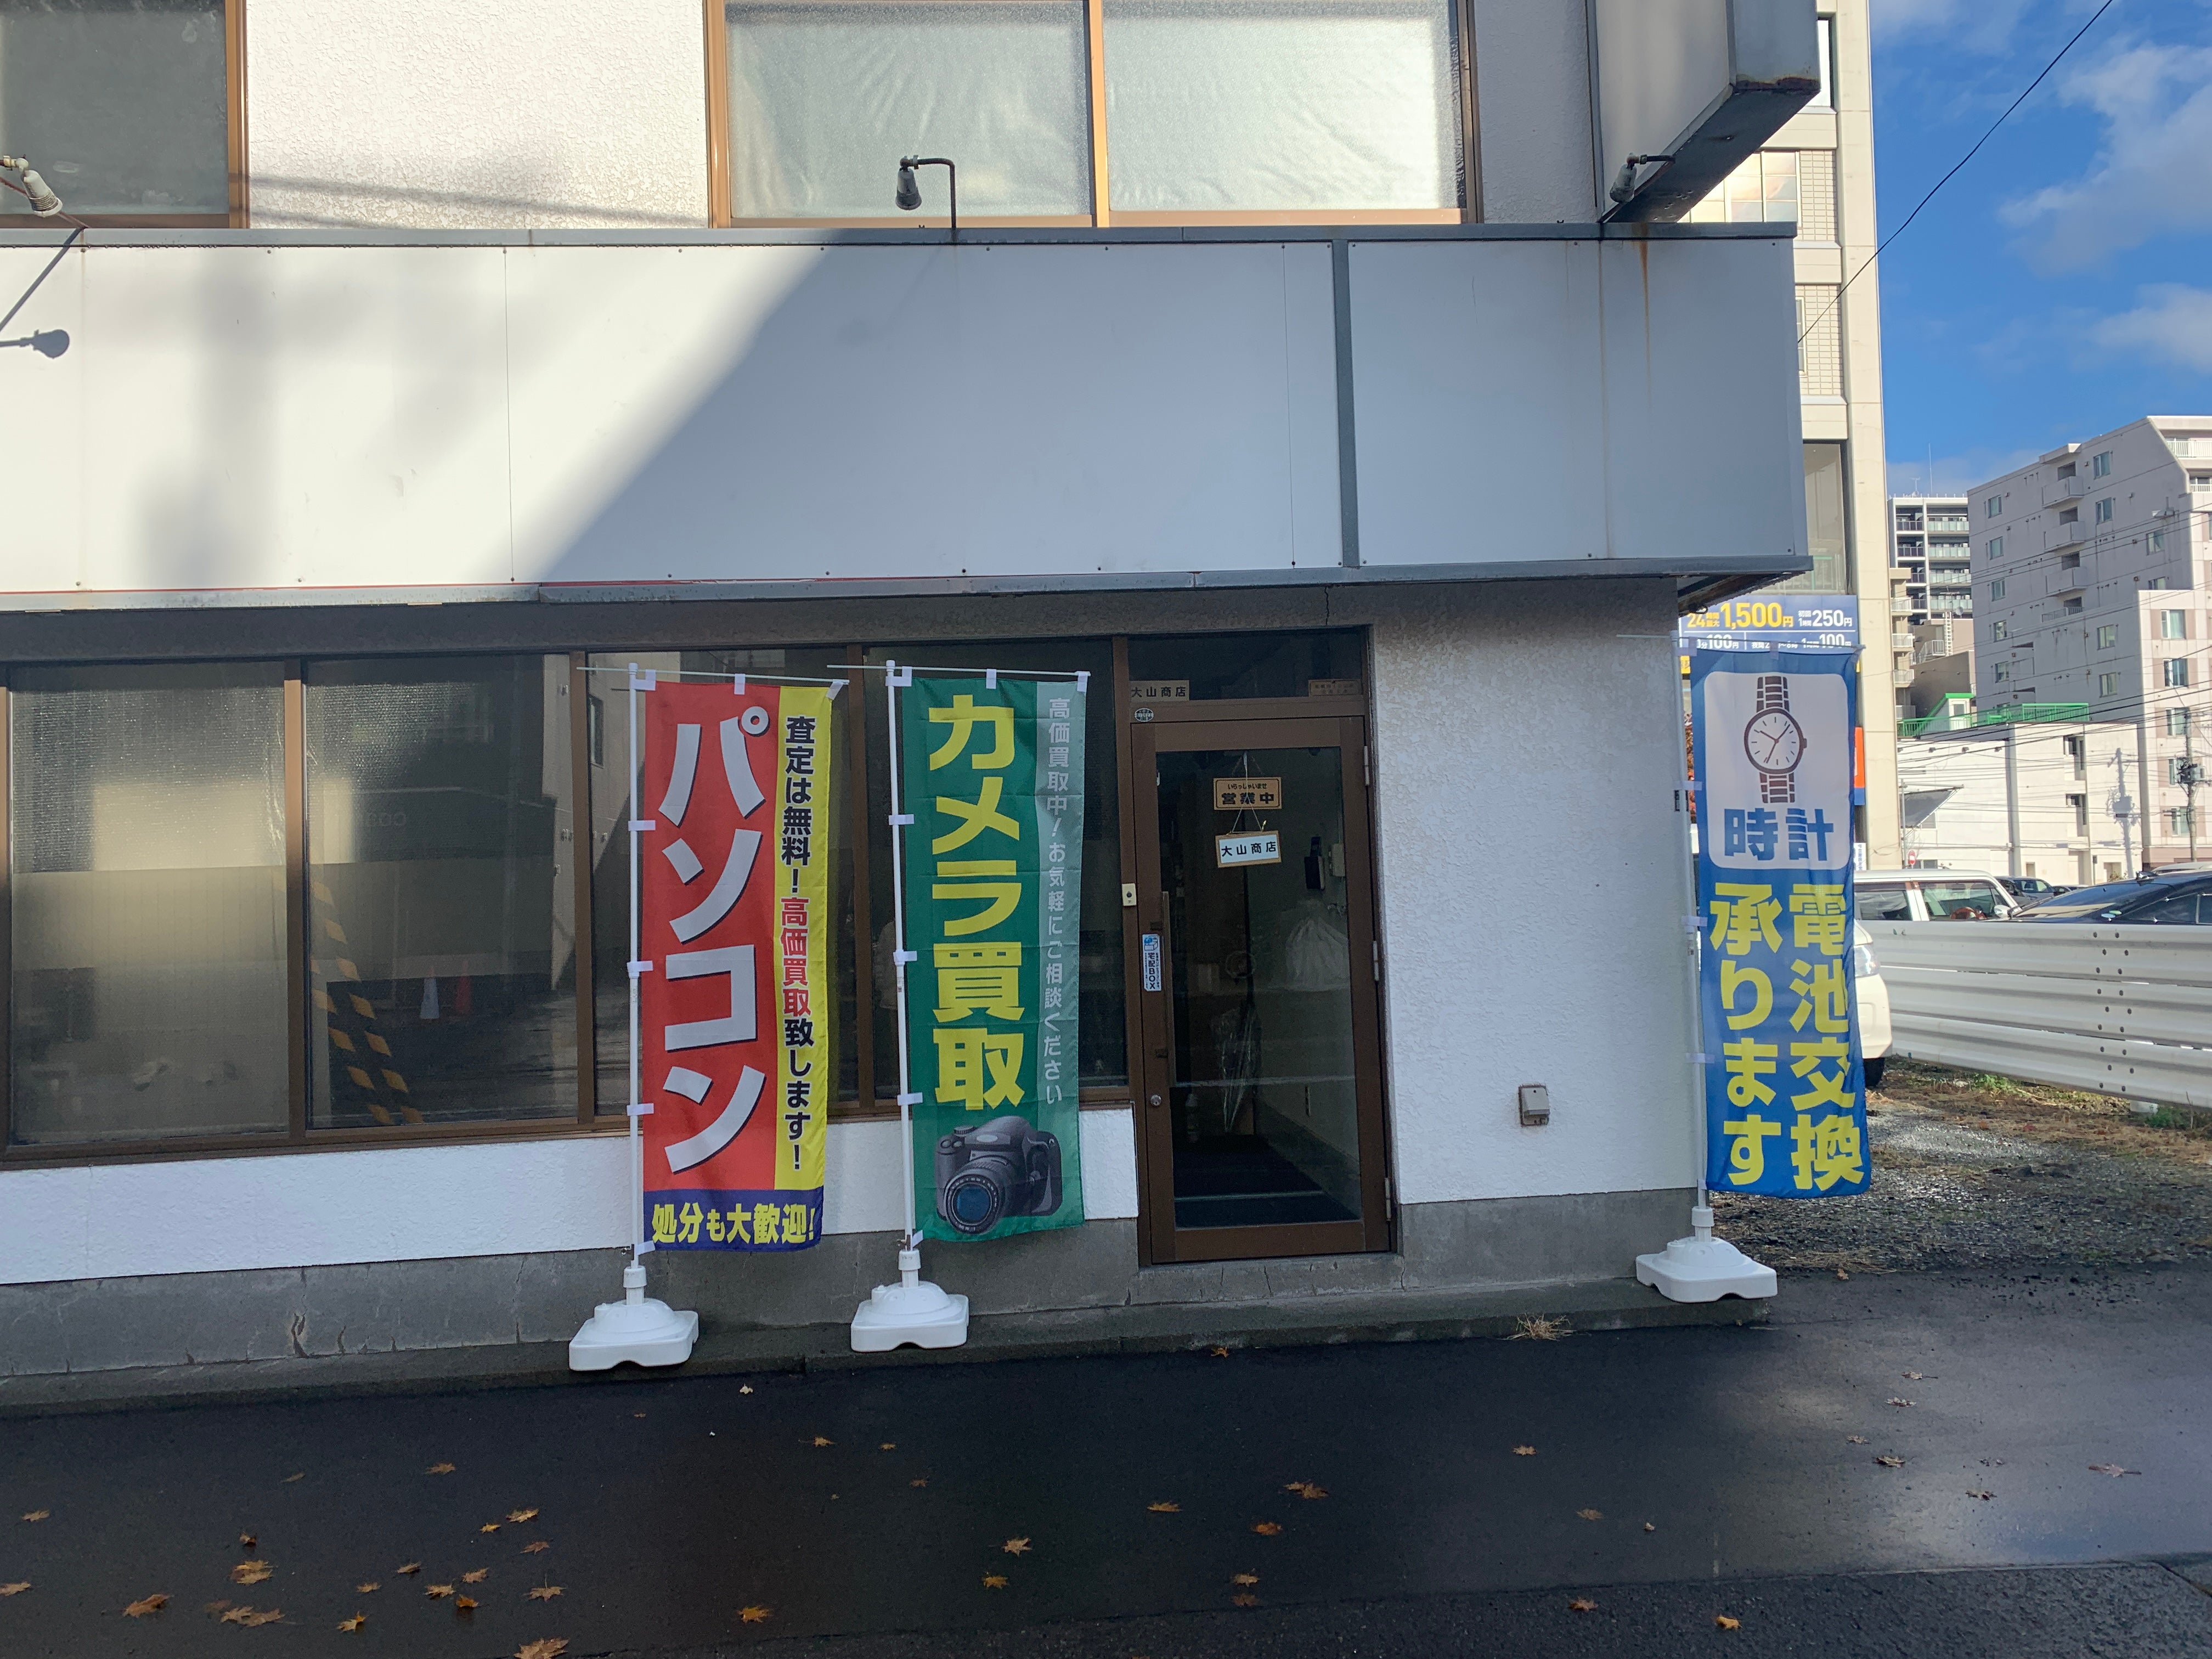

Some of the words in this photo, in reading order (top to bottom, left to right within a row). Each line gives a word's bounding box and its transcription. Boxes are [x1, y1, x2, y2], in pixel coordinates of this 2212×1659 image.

[1720, 602, 1793, 629] 1,500円
[1812, 610, 1852, 627] 250円
[1131, 686, 1186, 697] 大山商店
[1221, 792, 1274, 805] 営業中
[1221, 841, 1277, 857] 大山商店
[1724, 808, 1834, 861] 時計
[929, 695, 1025, 1110] カメラ買取
[658, 706, 769, 1174] パソコン
[1709, 882, 1783, 1186] 承ります
[1789, 884, 1864, 1191] 電池交換
[652, 1202, 816, 1245] 処分も大歓迎！
